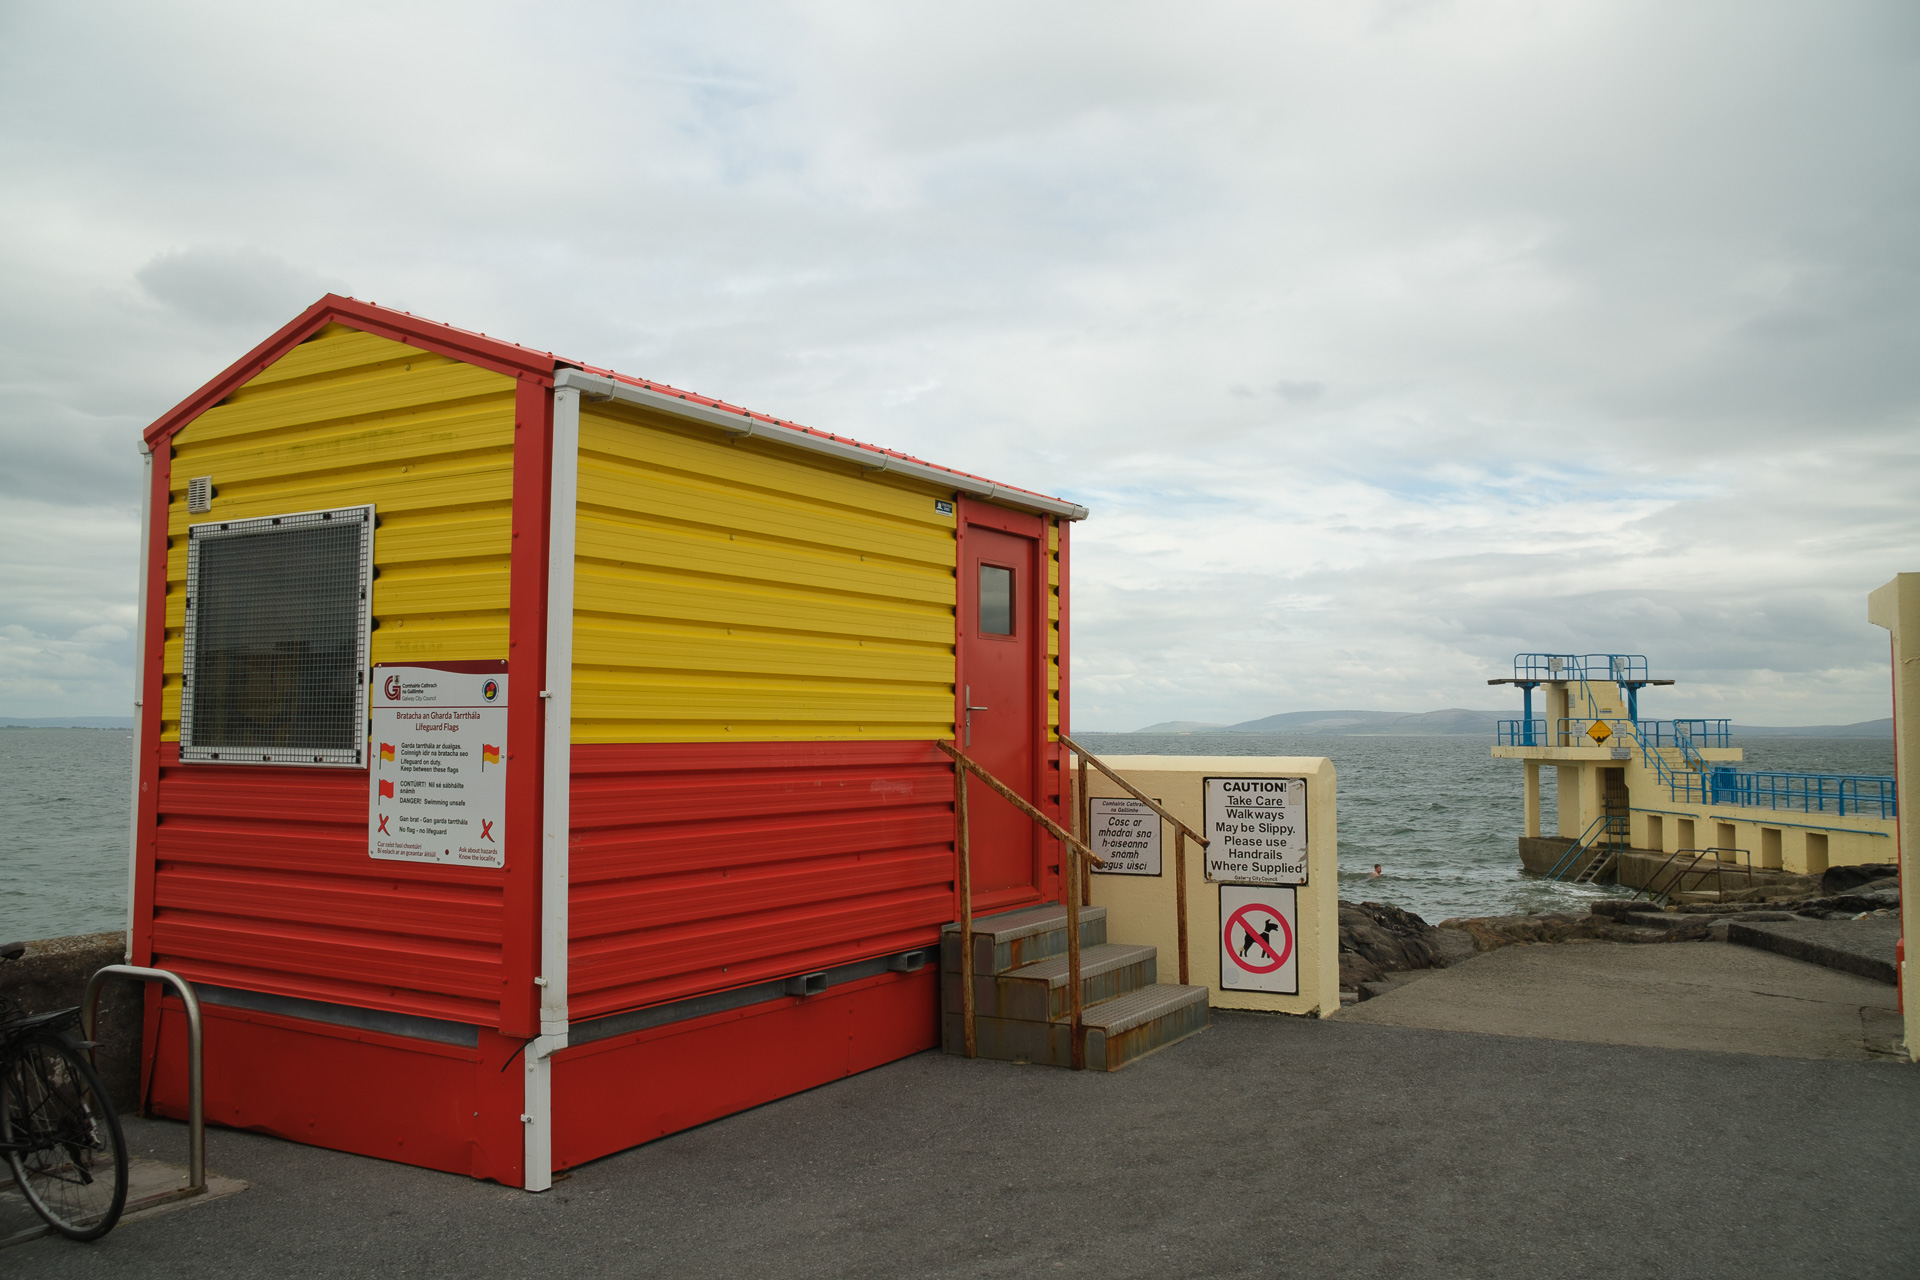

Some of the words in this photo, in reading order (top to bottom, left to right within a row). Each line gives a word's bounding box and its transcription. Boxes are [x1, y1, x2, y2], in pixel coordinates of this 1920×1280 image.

[416, 723, 442, 732] Lifeguard
[444, 723, 459, 731] Flags
[1223, 782, 1287, 792] CAUTION!
[1227, 796, 1252, 805] Take
[1256, 796, 1282, 806] Care
[1226, 809, 1284, 821] Walkways
[1109, 817, 1130, 826] Cosc
[1216, 822, 1238, 833] May
[1241, 823, 1254, 832] be
[1259, 823, 1295, 835] Slippy.
[1224, 836, 1262, 846] Please
[1229, 849, 1282, 860] Handrails
[1211, 861, 1248, 871] Where
[1252, 862, 1302, 874] Supplied
